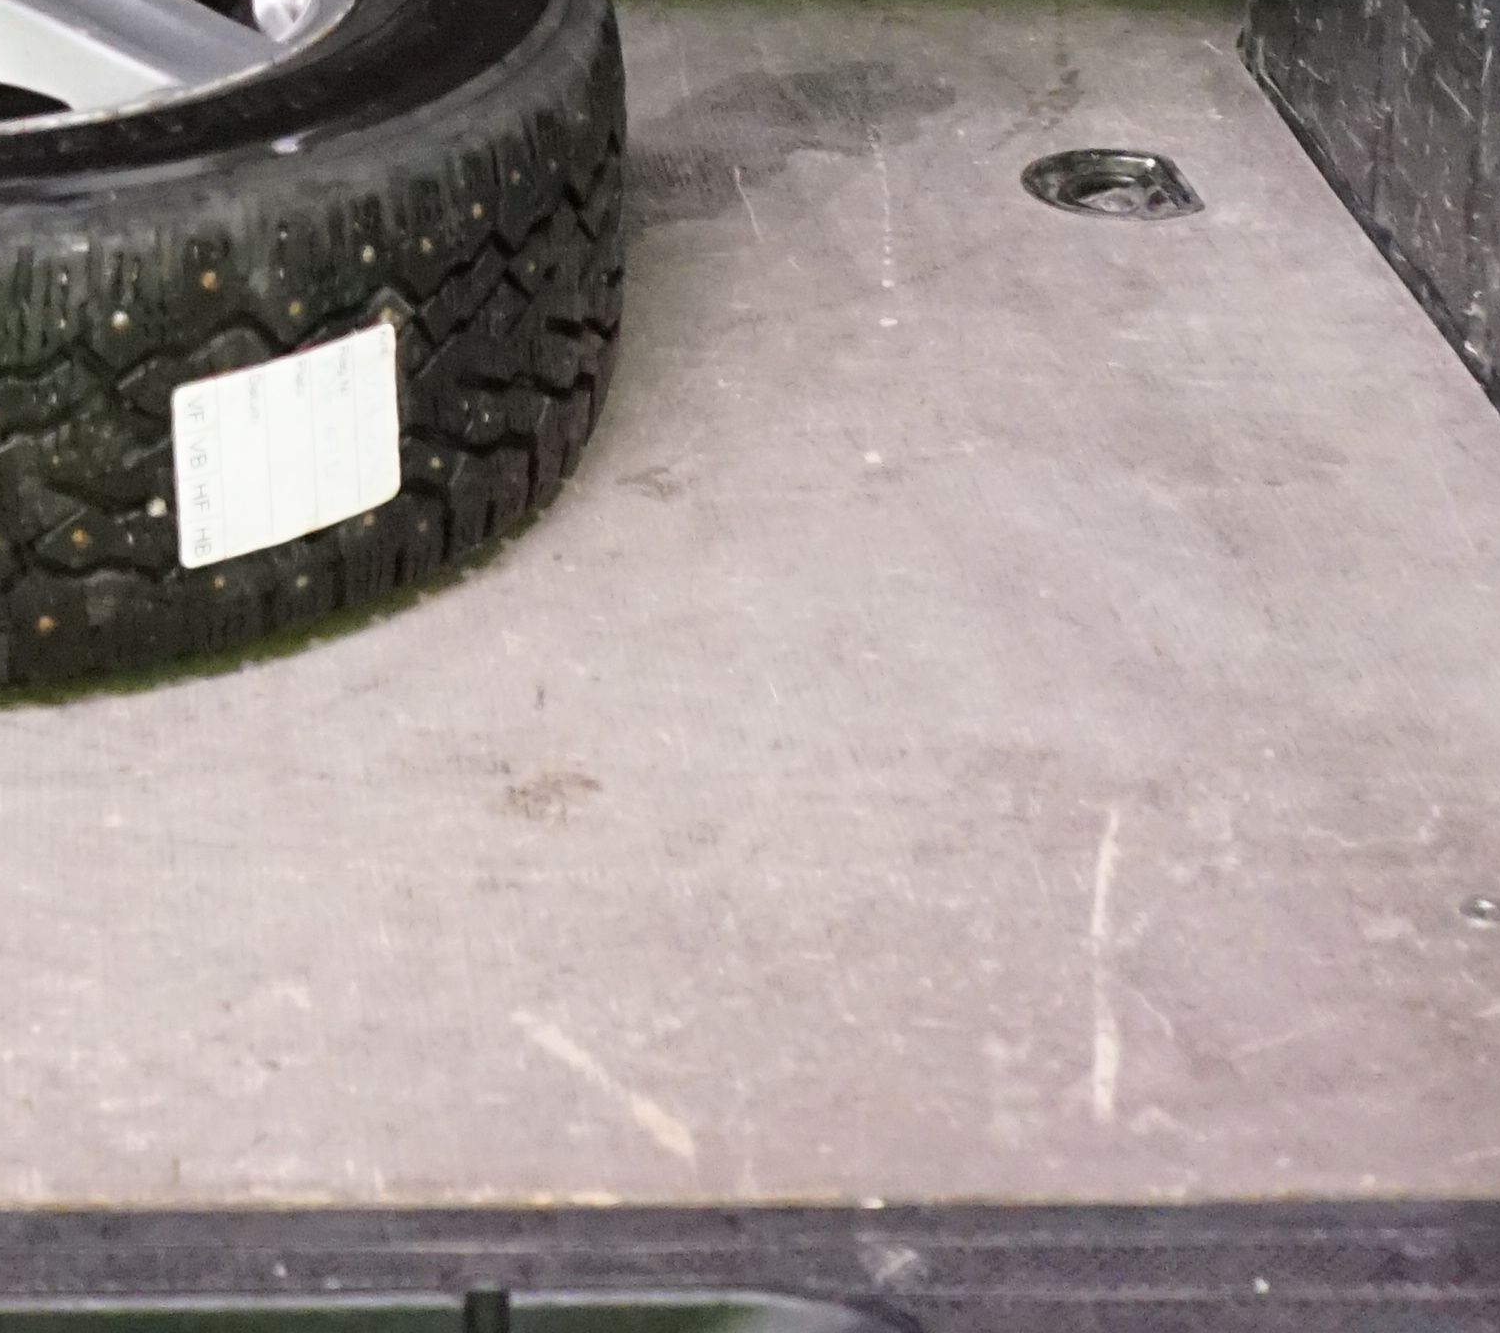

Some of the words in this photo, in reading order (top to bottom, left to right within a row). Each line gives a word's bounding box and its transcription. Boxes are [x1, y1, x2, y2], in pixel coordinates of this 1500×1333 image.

[186, 395, 206, 424] VF
[189, 436, 208, 470] VB
[191, 482, 211, 514] HF
[193, 526, 212, 559] HB
